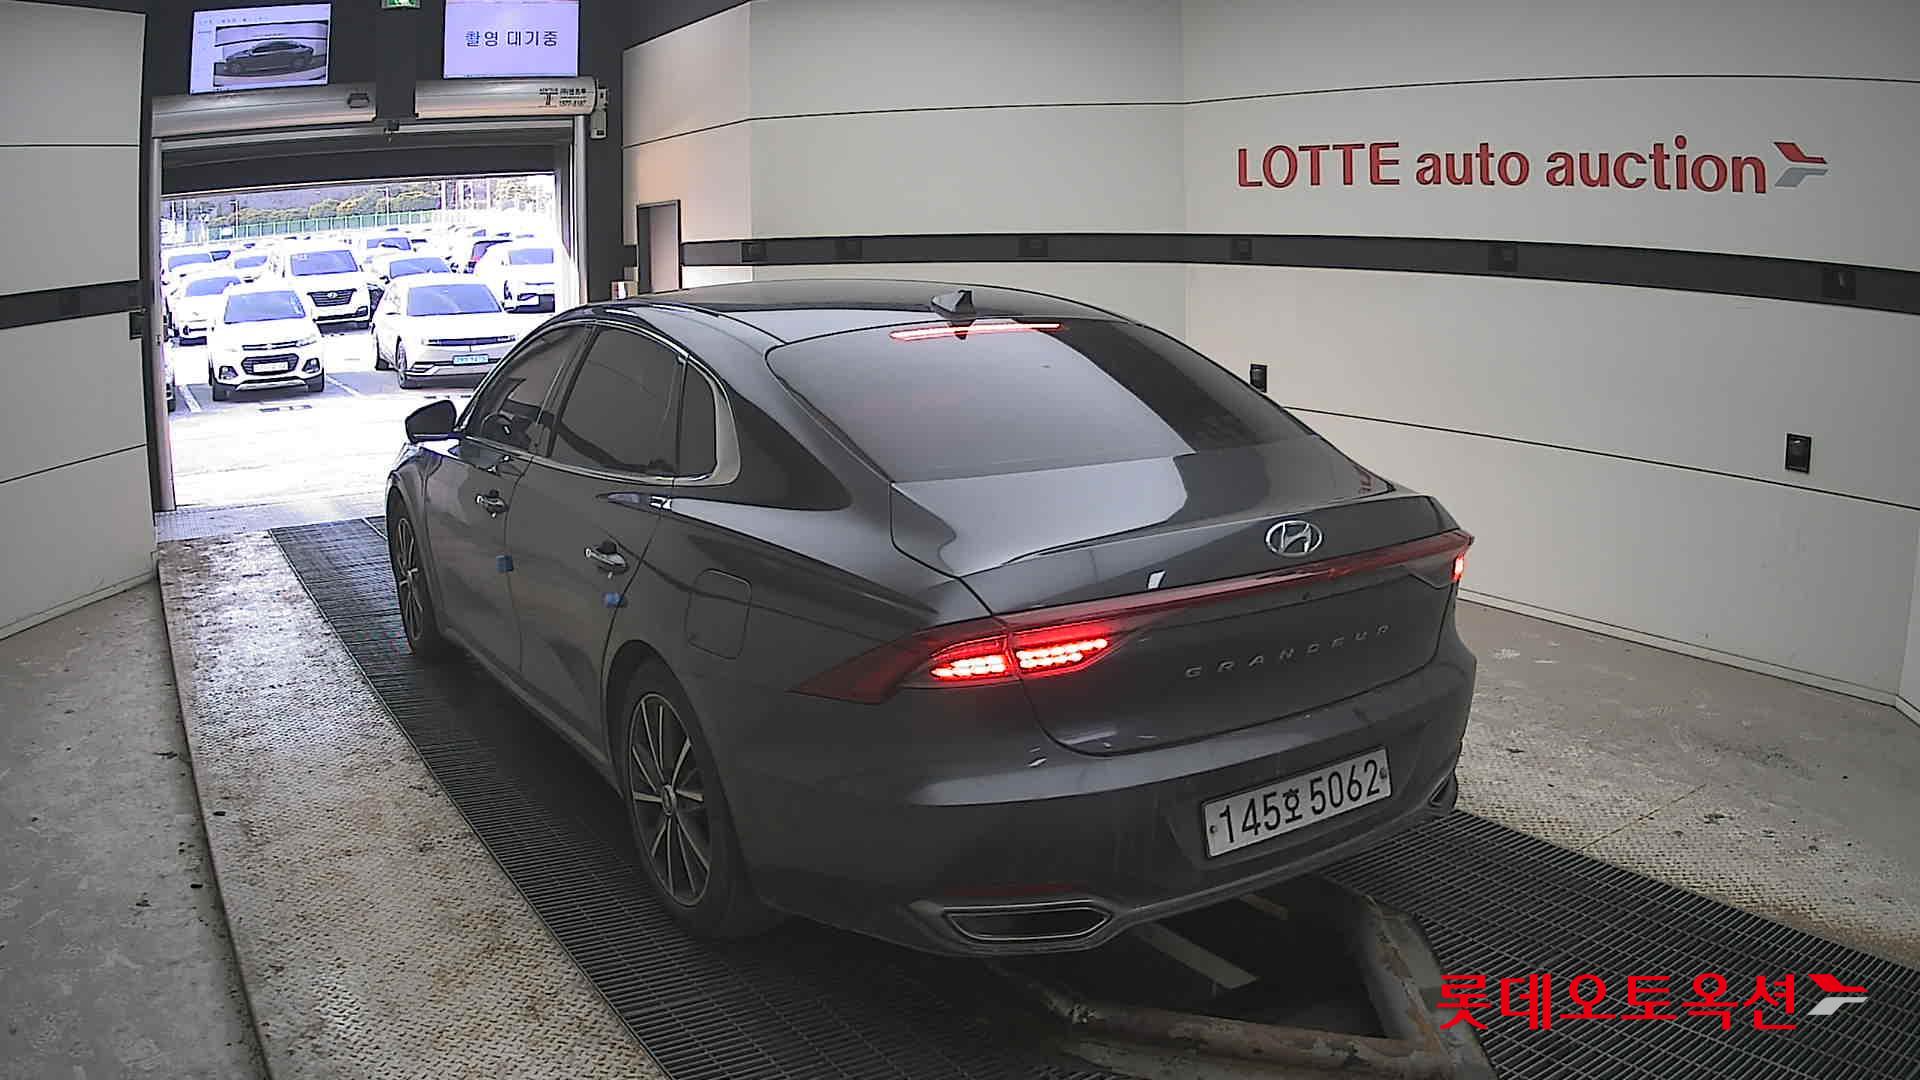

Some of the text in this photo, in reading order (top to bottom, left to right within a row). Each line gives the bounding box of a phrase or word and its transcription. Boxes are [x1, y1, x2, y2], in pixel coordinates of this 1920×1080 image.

[507, 31, 558, 47] 대기중
[1238, 135, 1767, 193] LOTTE auto auction
[1185, 625, 1389, 678] GRANDEUR
[1219, 759, 1380, 843] 145호 5062
